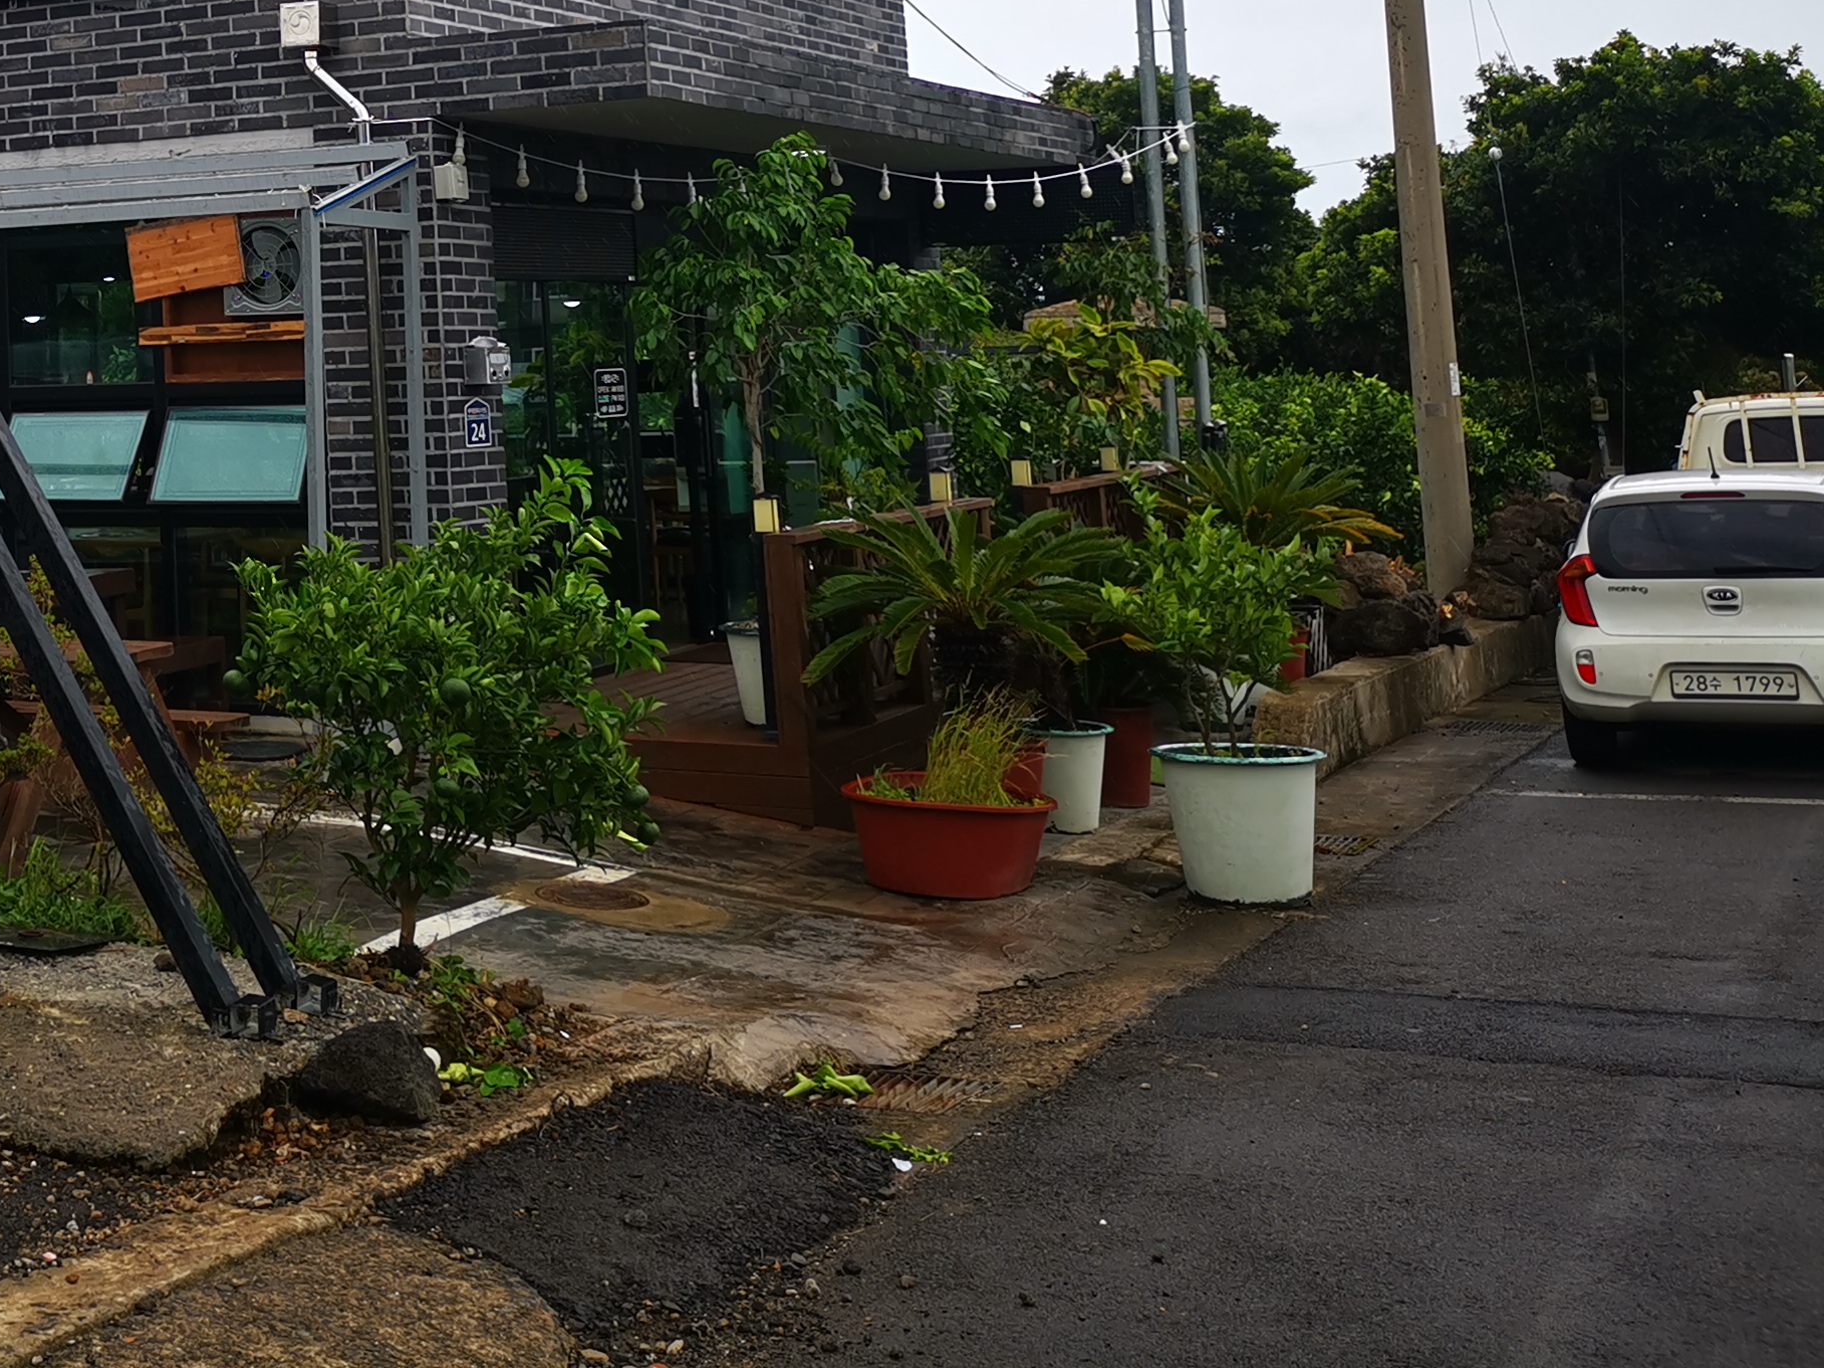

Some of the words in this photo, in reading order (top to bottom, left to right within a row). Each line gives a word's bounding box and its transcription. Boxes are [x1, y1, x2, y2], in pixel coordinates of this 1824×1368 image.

[471, 422, 486, 441] 24
[1607, 585, 1648, 595] morning
[1683, 675, 1722, 692] 28수
[1733, 675, 1784, 693] 1799
